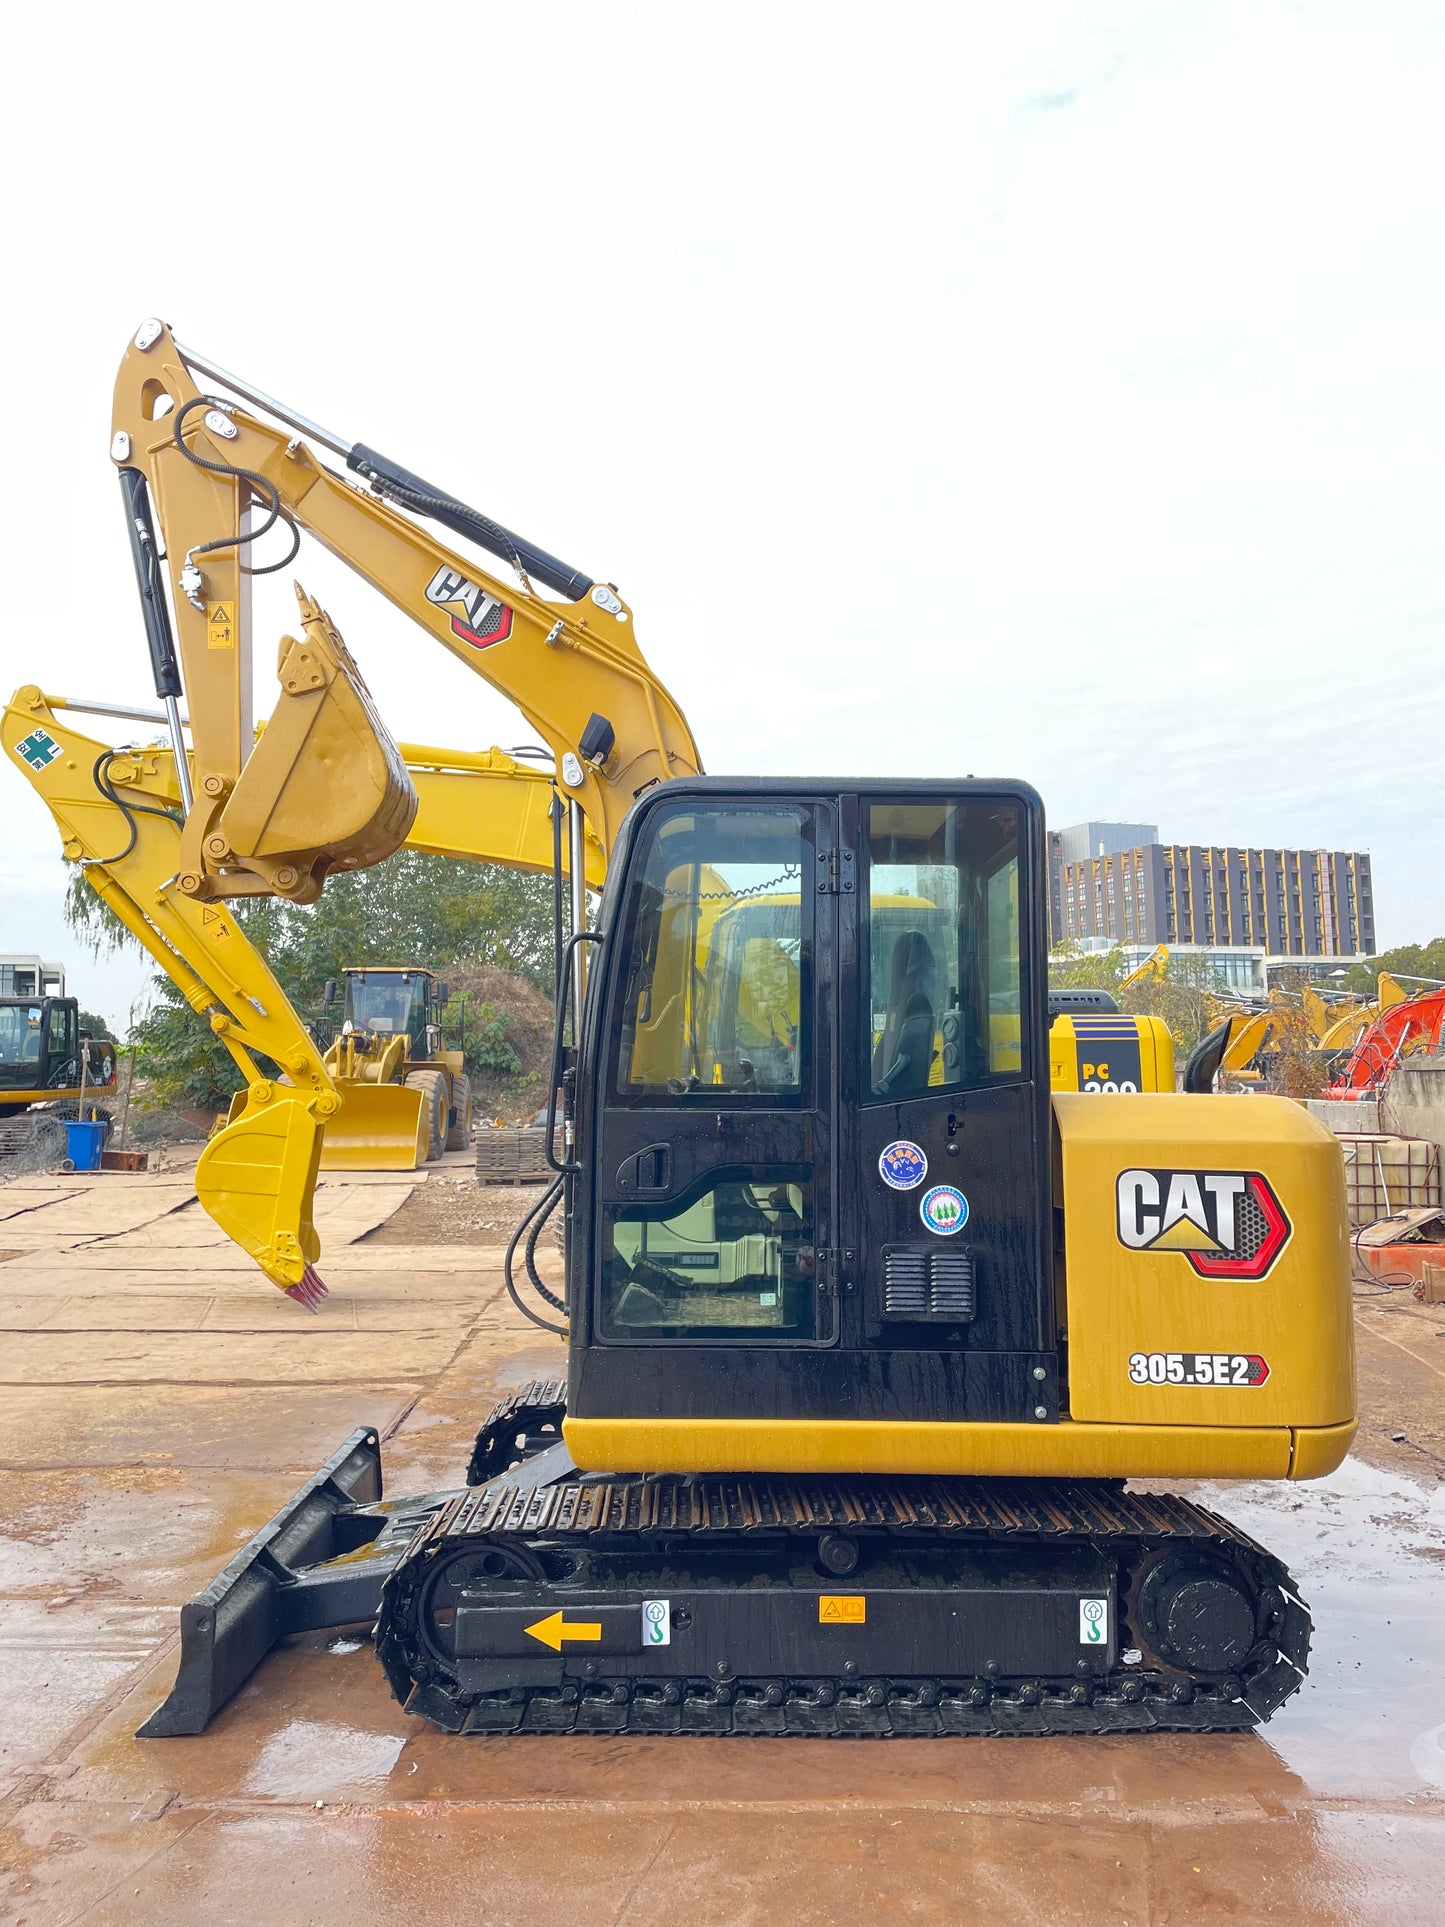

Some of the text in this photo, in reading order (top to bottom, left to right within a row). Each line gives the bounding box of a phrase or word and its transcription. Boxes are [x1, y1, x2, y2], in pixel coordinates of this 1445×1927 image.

[426, 564, 503, 629] CAT
[1082, 1063, 1110, 1079] PC
[1118, 1170, 1245, 1250] CAT
[1130, 1354, 1249, 1384] 305.5E2
